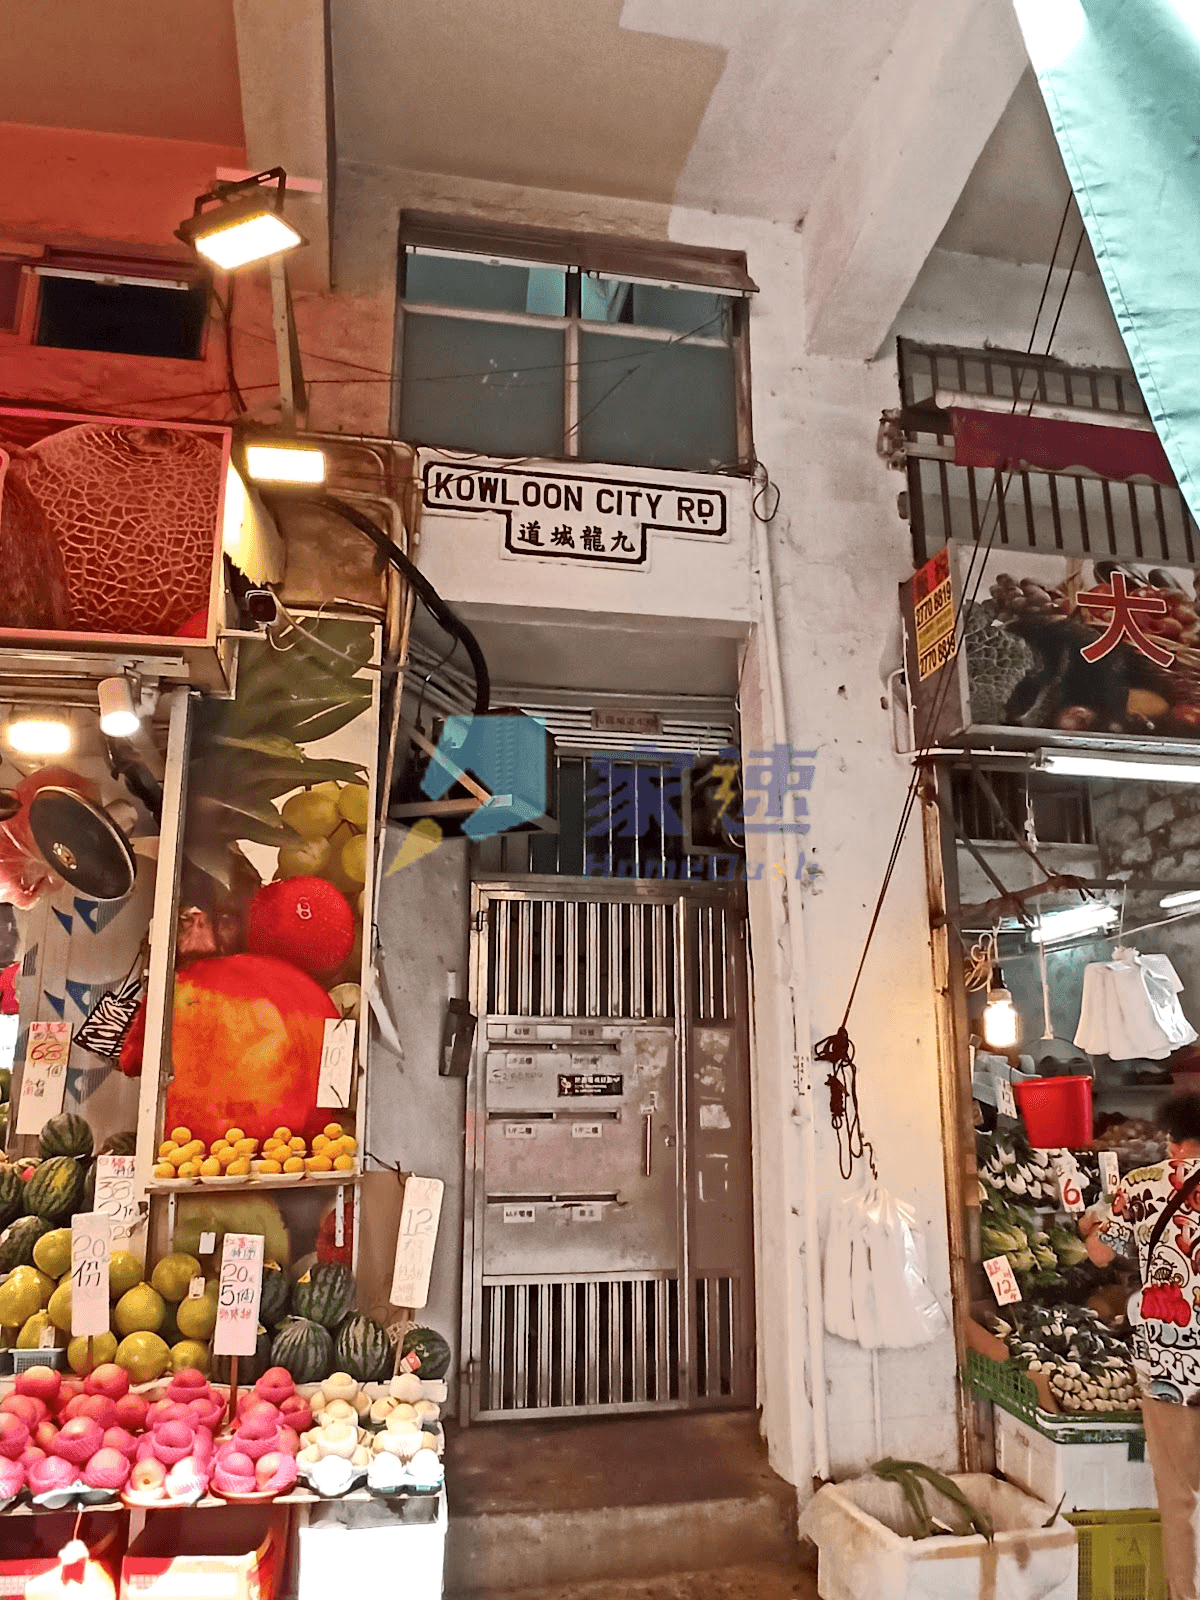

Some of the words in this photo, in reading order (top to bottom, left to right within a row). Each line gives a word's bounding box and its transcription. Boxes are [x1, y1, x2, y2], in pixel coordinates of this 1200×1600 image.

[434, 472, 583, 512] KOWLOON
[595, 489, 662, 519] CITY
[1076, 570, 1175, 668] 大
[1063, 1178, 1081, 1205] 6
